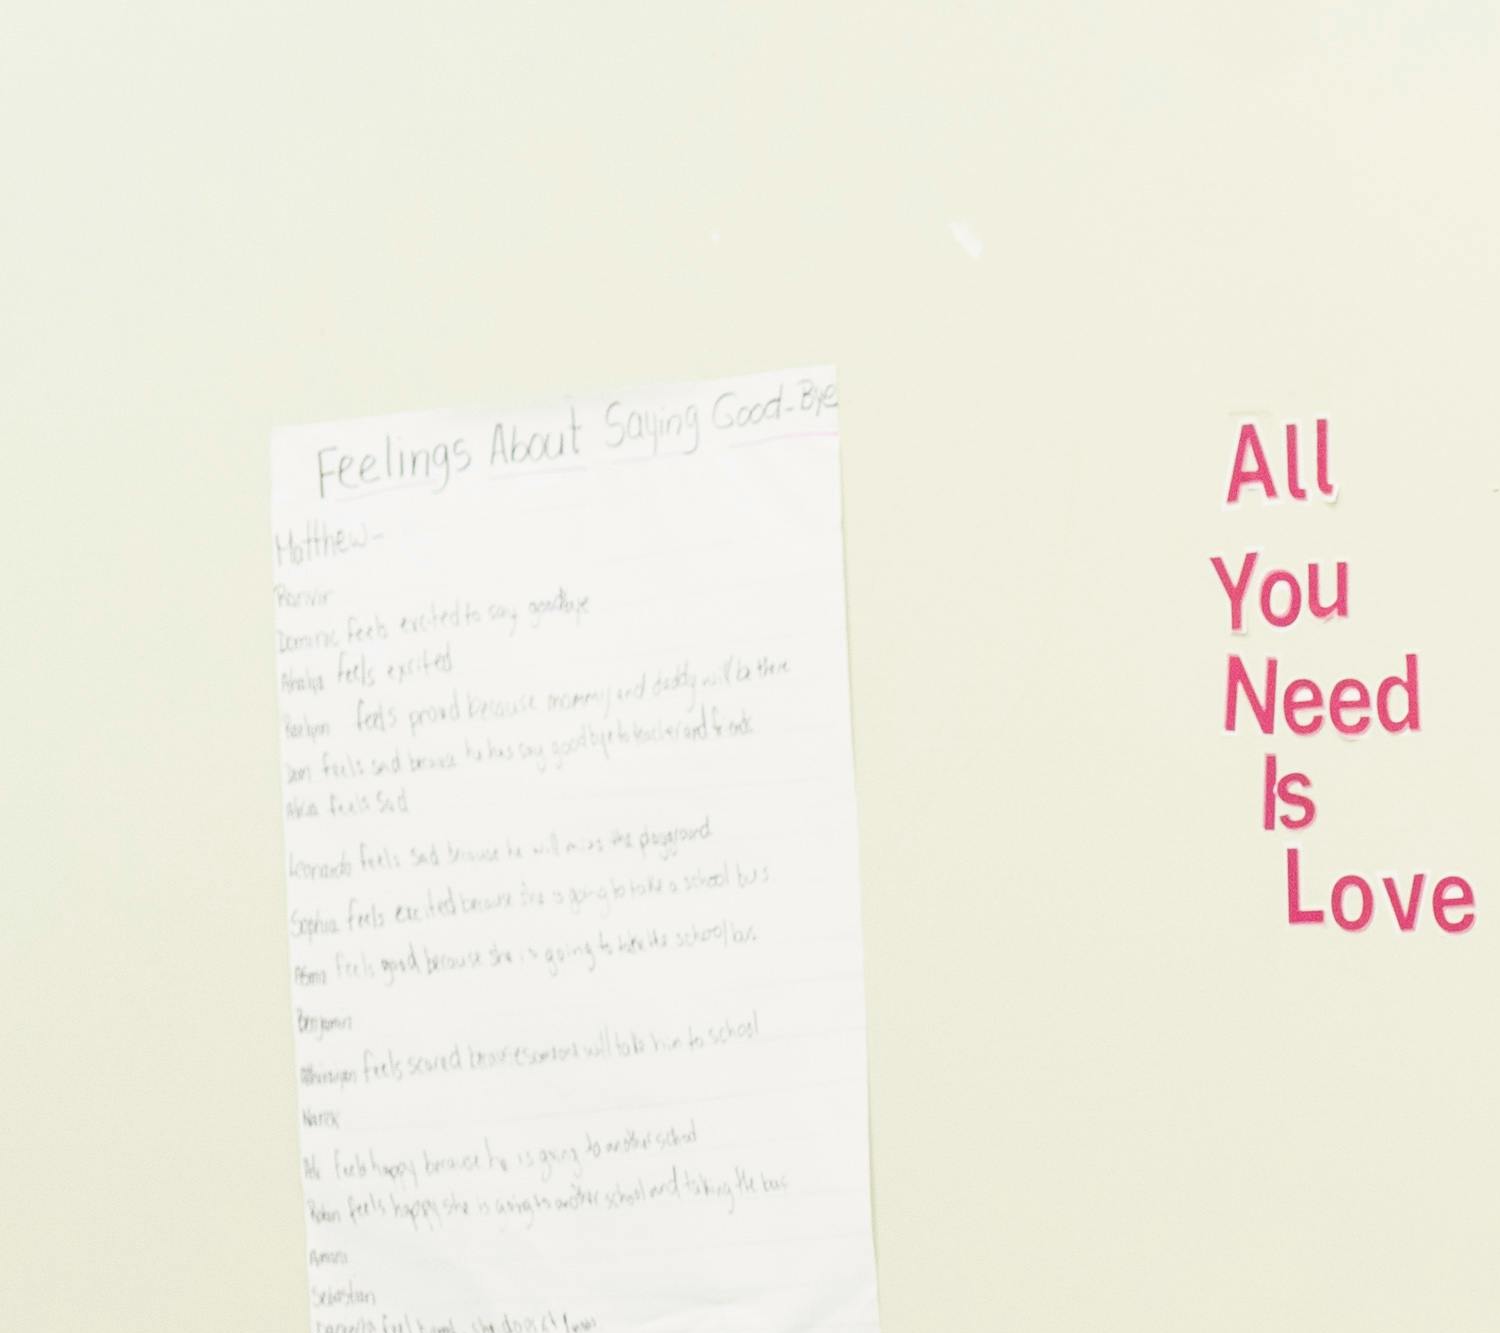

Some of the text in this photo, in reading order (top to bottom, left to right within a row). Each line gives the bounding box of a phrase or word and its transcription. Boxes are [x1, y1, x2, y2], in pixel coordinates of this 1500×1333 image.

[315, 436, 472, 499] Feelings
[487, 407, 584, 466] About
[602, 399, 700, 455] Saying
[1226, 418, 1333, 504] All
[1210, 552, 1348, 630] You
[1224, 653, 1421, 734] Need
[1264, 754, 1316, 830] Is
[1286, 848, 1475, 932] Love
